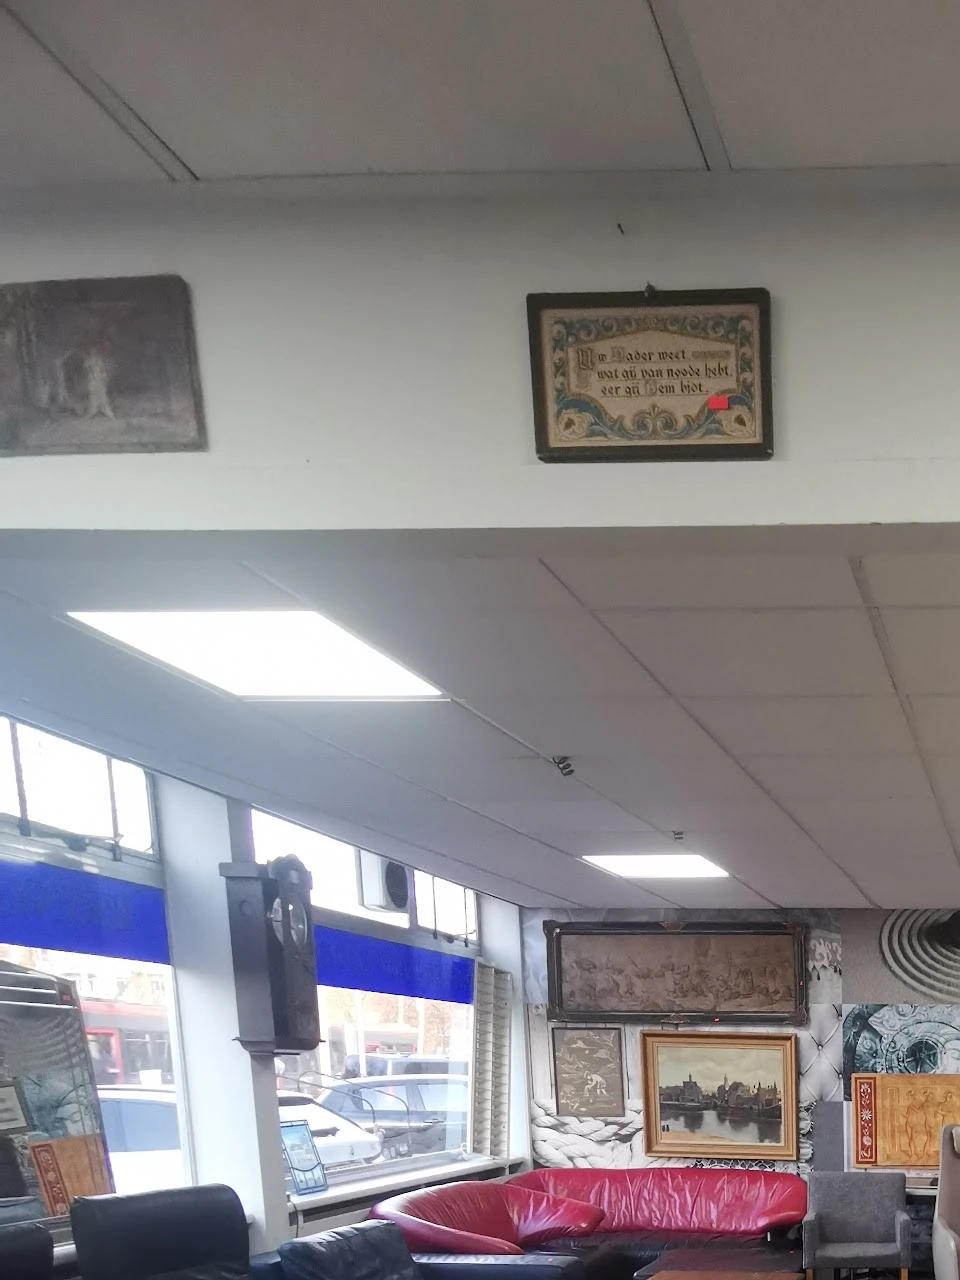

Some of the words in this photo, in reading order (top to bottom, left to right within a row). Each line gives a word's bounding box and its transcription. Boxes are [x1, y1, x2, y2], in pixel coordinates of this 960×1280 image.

[658, 350, 686, 361] weet
[597, 368, 619, 379] wat
[641, 368, 664, 379] van
[667, 364, 700, 377] noode
[601, 386, 620, 396] eer
